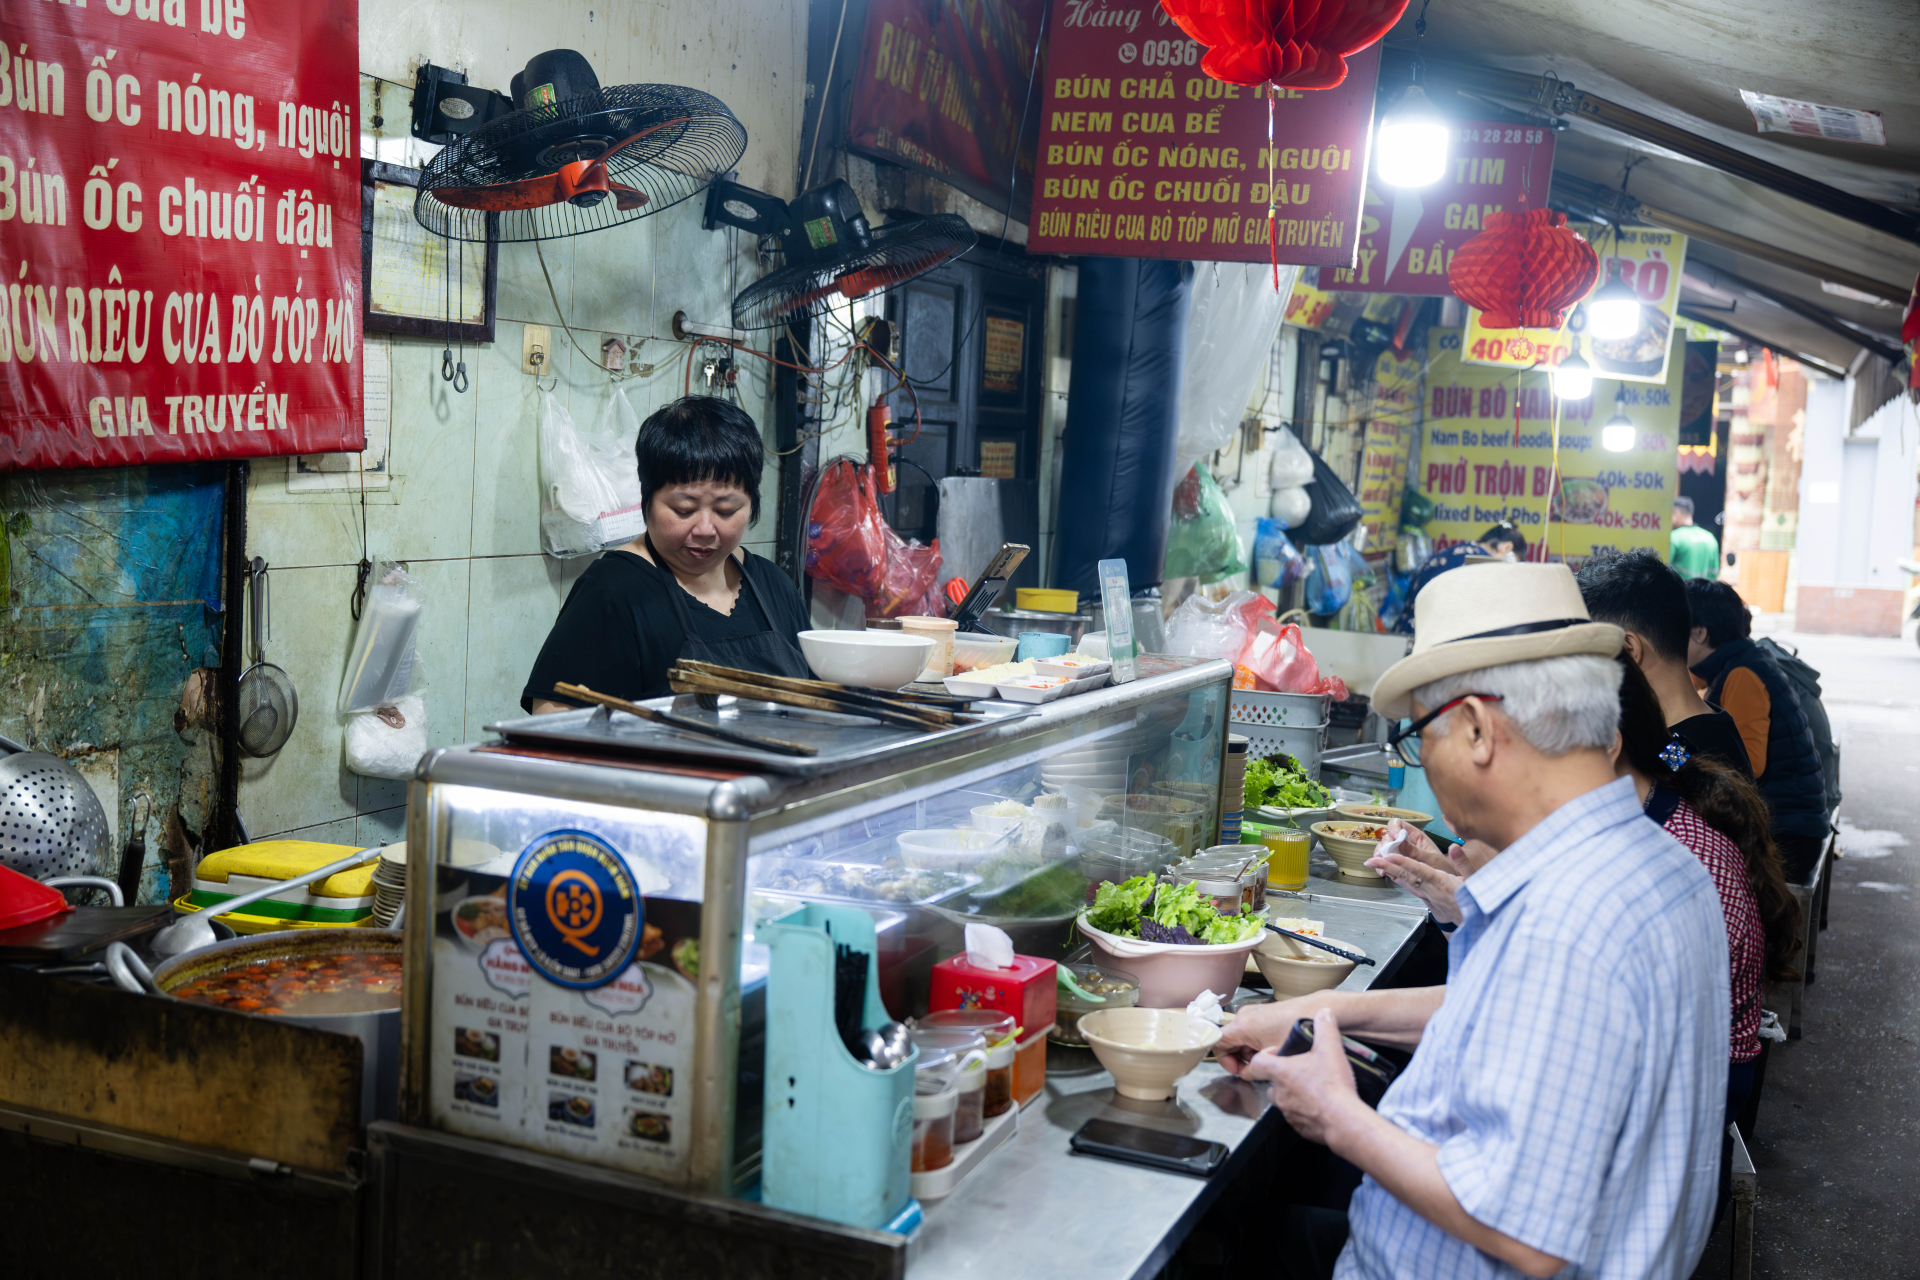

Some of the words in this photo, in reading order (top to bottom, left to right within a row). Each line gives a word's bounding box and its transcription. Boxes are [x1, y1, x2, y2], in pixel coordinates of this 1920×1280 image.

[1142, 40, 1198, 66] 0936
[1055, 74, 1111, 98] BÚN
[1120, 71, 1175, 98] CHẢ
[86, 50, 141, 126] ốc
[158, 73, 265, 151] nóng,
[278, 101, 351, 169] nguội
[1051, 112, 1112, 132] NEM
[1122, 112, 1175, 133] CUA
[1185, 105, 1225, 134] BỂ
[1483, 129, 1500, 143] 28
[1504, 130, 1522, 144] 28
[1047, 140, 1104, 166] BÚN
[1112, 140, 1149, 167] ỐC
[1158, 142, 1246, 171] NÓNG,
[1258, 144, 1350, 174] NGUỘI
[1456, 158, 1505, 185] TIM
[83, 158, 142, 233] ốc
[160, 175, 264, 242] chuối
[276, 189, 332, 258] đậu
[1043, 174, 1100, 200] BÚN
[1108, 173, 1145, 201] ỐC
[1155, 175, 1241, 203] CHUỐI
[1250, 179, 1310, 209] ĐẬU
[1039, 207, 1071, 238] BÚN
[1075, 208, 1111, 239] RIÊU
[1115, 215, 1145, 240] CUA
[1152, 210, 1172, 242] BÒ
[1178, 212, 1207, 242] TÓP
[1212, 212, 1240, 244] MỠ
[1244, 218, 1271, 246] GIA
[1278, 212, 1344, 248] TRUYỀN
[66, 264, 153, 364] RIÊU
[162, 292, 220, 364] CUA
[228, 275, 264, 364] BÒ
[272, 277, 319, 364] TÓP
[323, 280, 354, 364] MỠ
[1512, 342, 1529, 358] 福
[89, 396, 154, 438] GIA
[165, 382, 288, 436] TRUYỀN
[1431, 381, 1473, 419] BÚN
[1430, 429, 1458, 446] Nam
[1462, 430, 1478, 446] Bo
[1482, 429, 1510, 447] beef
[1426, 456, 1467, 494] PHỞ
[1474, 459, 1526, 502] TRỘN
[1474, 504, 1508, 523] beef
[1512, 507, 1541, 525] Pho
